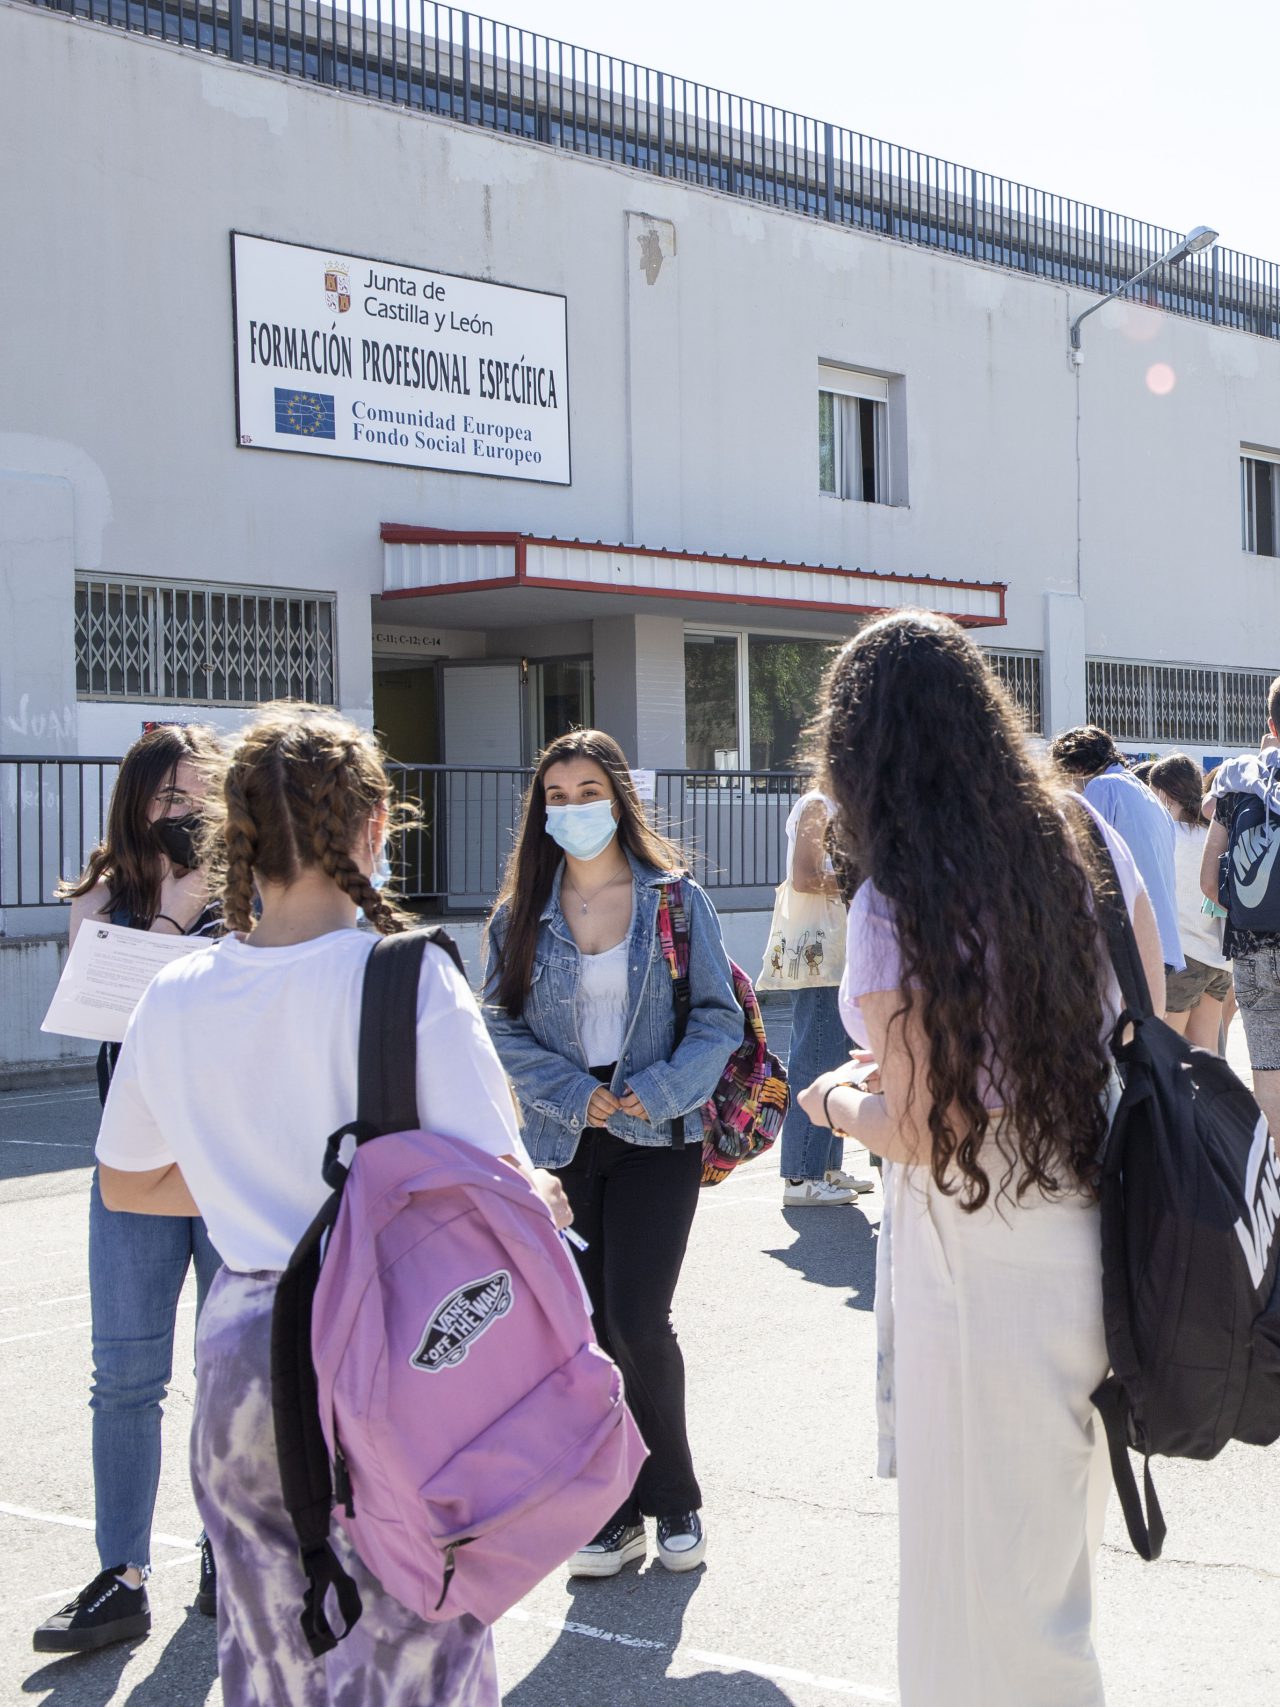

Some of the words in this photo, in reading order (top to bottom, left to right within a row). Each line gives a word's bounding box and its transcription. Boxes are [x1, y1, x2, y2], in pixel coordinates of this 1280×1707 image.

[363, 269, 417, 296] Junta
[422, 281, 446, 302] de
[363, 296, 429, 325] Castilla
[434, 312, 446, 333] y
[450, 311, 493, 336] León
[250, 320, 352, 379] FORMACIÓN
[361, 338, 471, 396] PROFESIONAL
[478, 353, 558, 409] ESPECÍFICA
[351, 400, 456, 432] Comunidad
[463, 415, 532, 443] Europea
[352, 422, 409, 447] Fondo
[415, 431, 466, 454] Social
[473, 438, 542, 466] Europeo
[432, 1293, 470, 1334] VANS
[447, 1310, 480, 1340] THE
